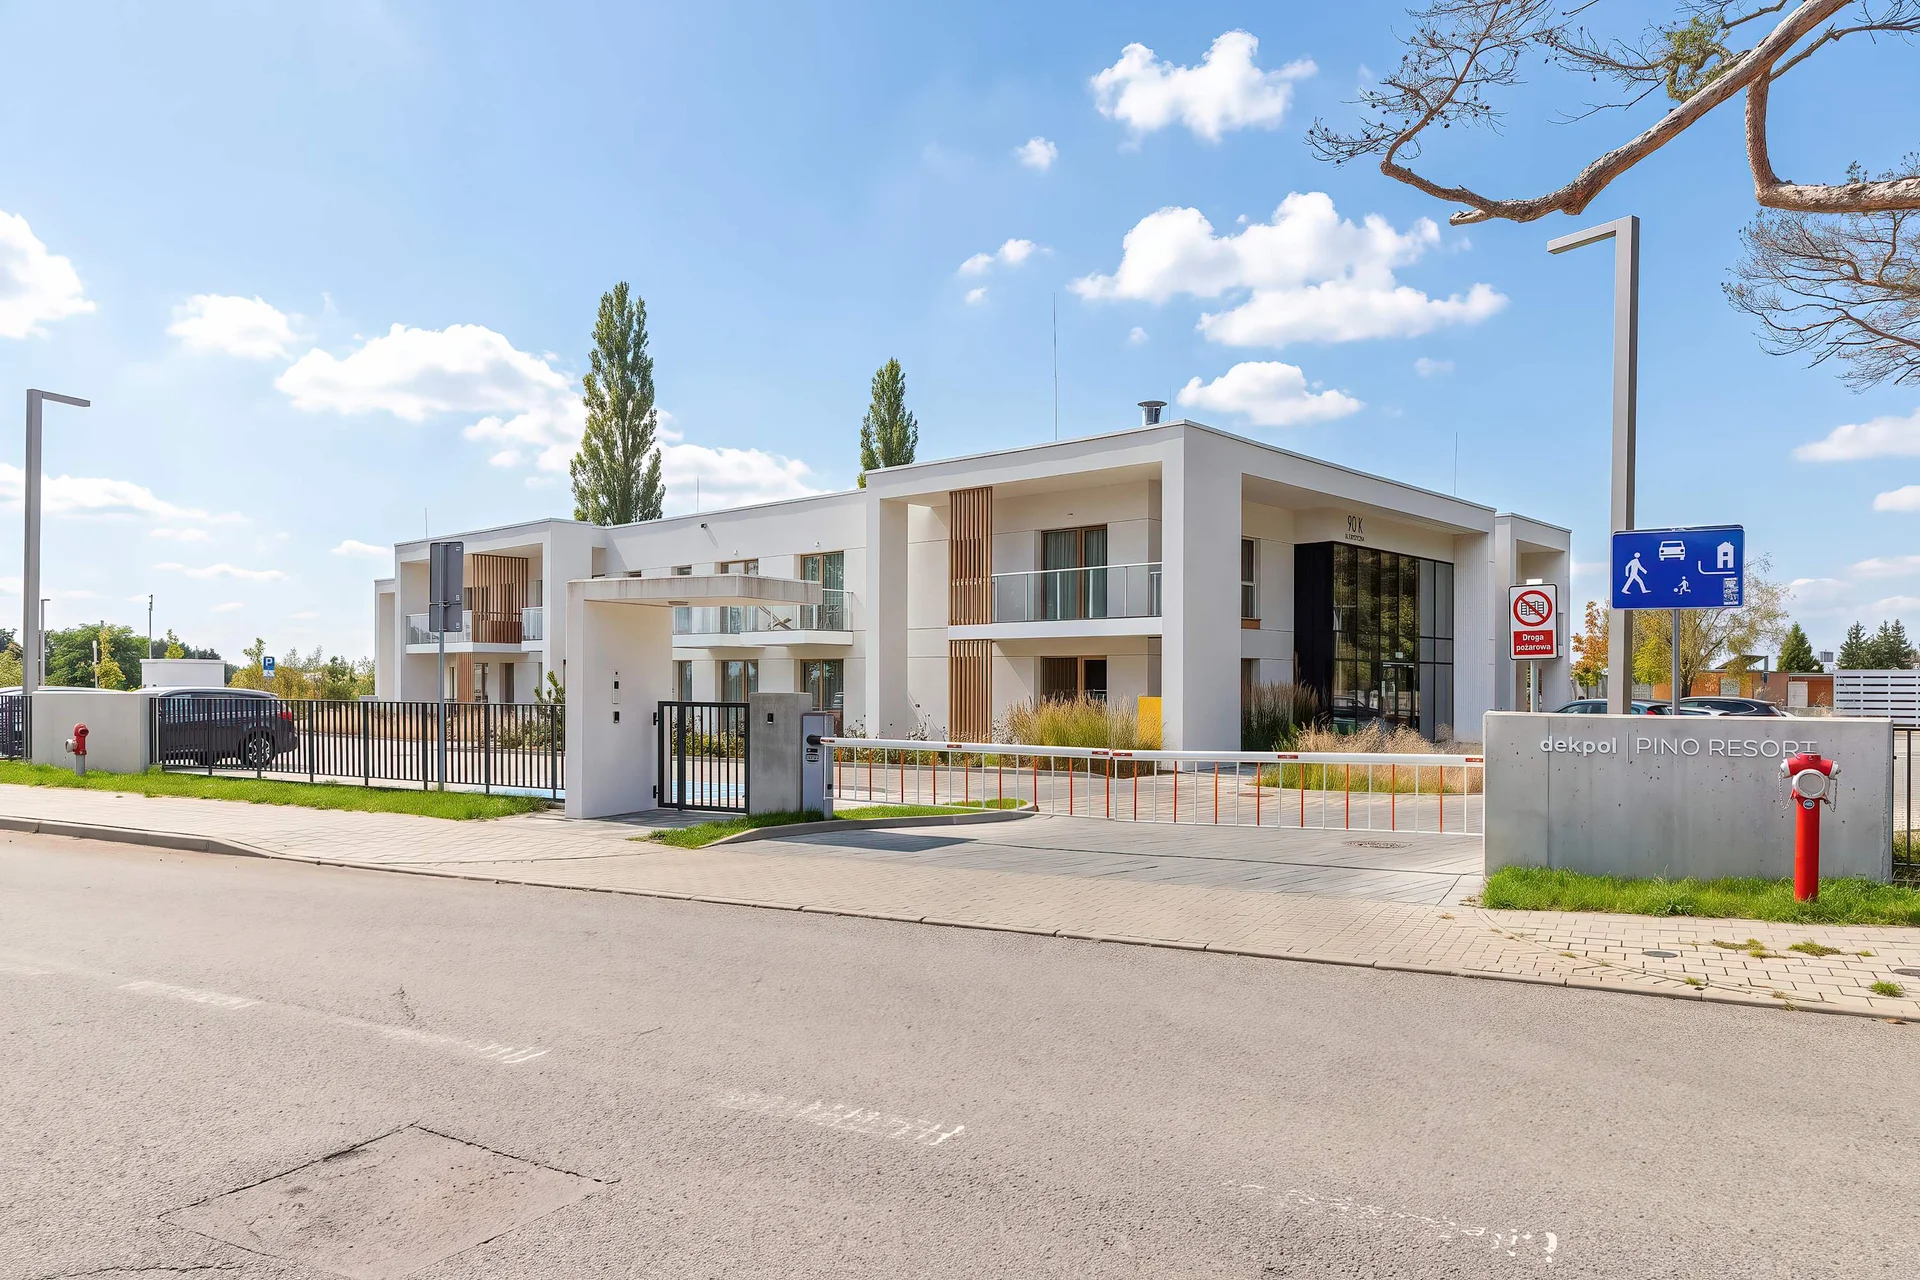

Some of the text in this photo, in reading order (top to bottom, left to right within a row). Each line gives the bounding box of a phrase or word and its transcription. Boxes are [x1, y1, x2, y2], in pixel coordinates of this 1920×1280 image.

[1347, 515, 1363, 534] 90 K
[1522, 633, 1545, 643] Droga
[1516, 643, 1551, 653] pożarowa
[265, 657, 273, 667] P
[1540, 735, 1818, 758] dekpol PINO RESORT
